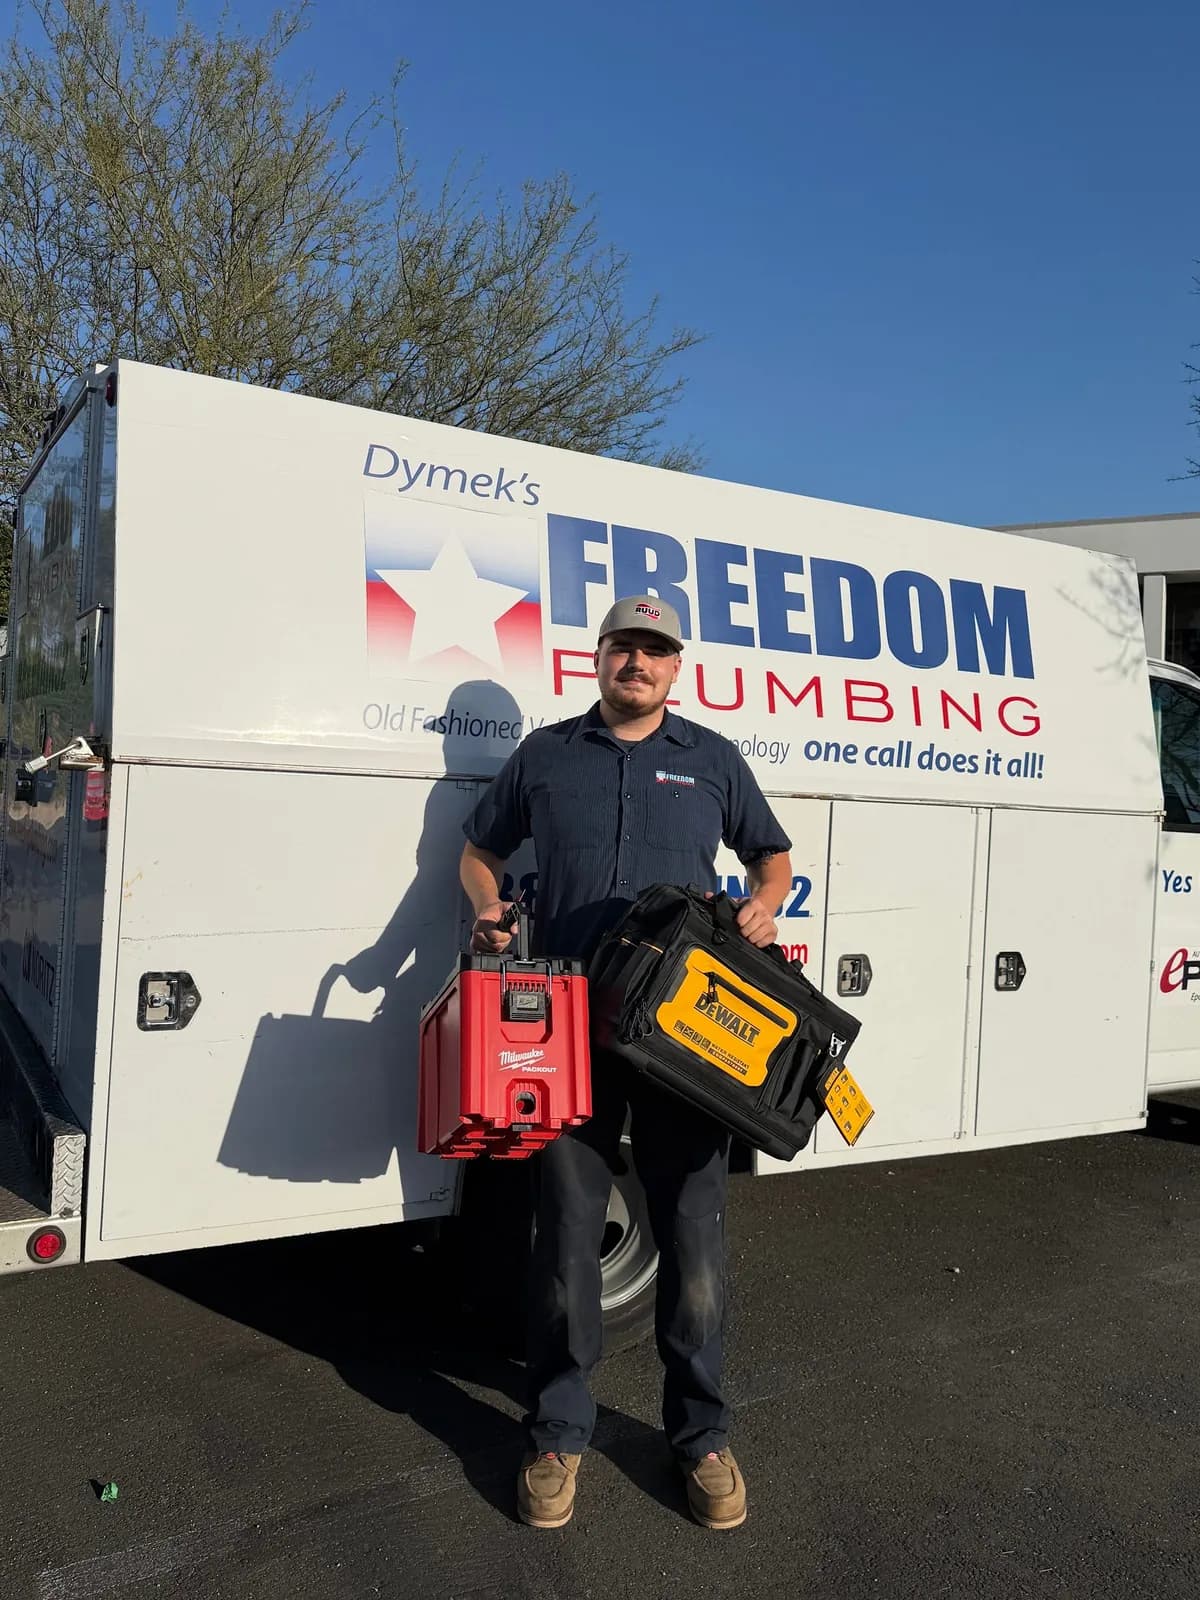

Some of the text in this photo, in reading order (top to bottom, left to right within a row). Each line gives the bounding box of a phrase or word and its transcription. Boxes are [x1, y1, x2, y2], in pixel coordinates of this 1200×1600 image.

[363, 443, 540, 506] Dymek's
[547, 513, 1035, 679] FREEDOM
[635, 605, 660, 617] RUUD
[553, 648, 1041, 736] PUMBING
[363, 703, 405, 732] Old
[411, 707, 524, 740] Fashioned
[804, 740, 1044, 779] one call does it all!
[1162, 869, 1192, 893] Yes
